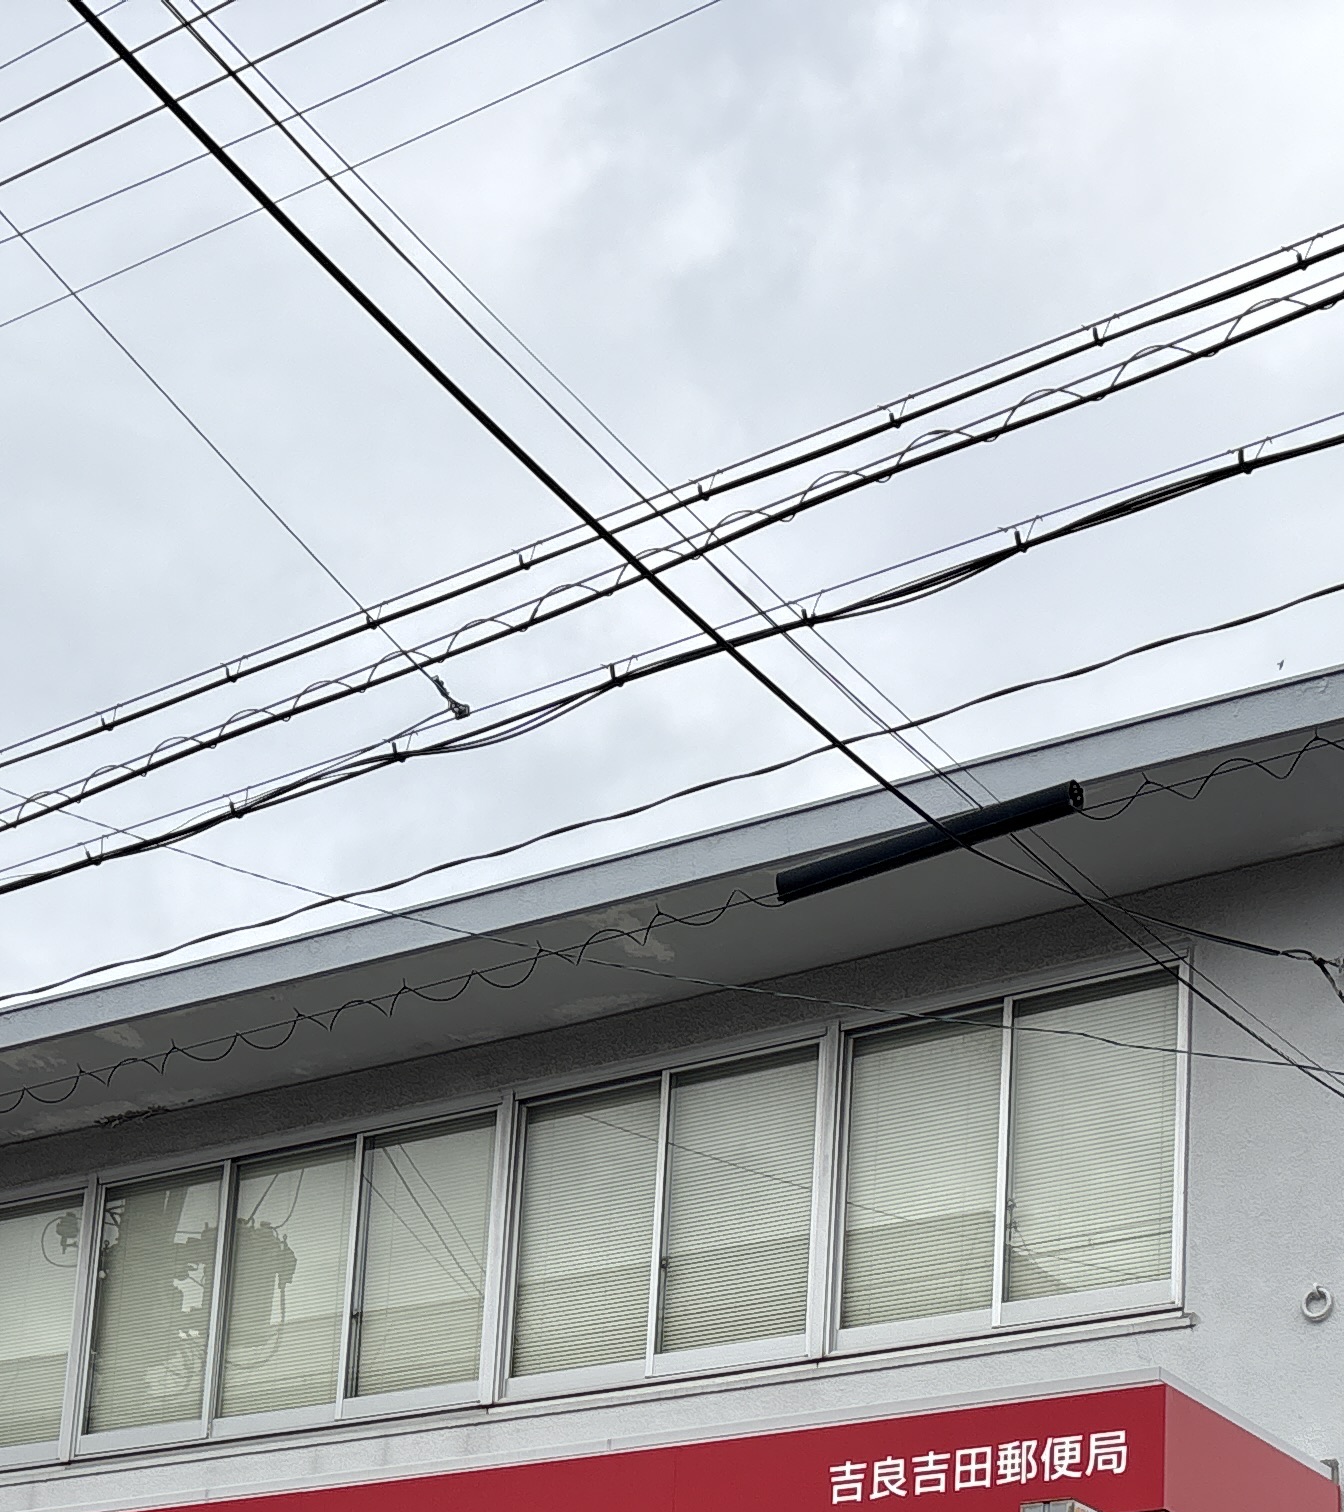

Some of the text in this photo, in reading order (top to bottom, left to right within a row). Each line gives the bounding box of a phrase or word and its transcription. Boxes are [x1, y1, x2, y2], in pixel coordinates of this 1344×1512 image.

[829, 1429, 1128, 1504] 吉良吉田郵便局
